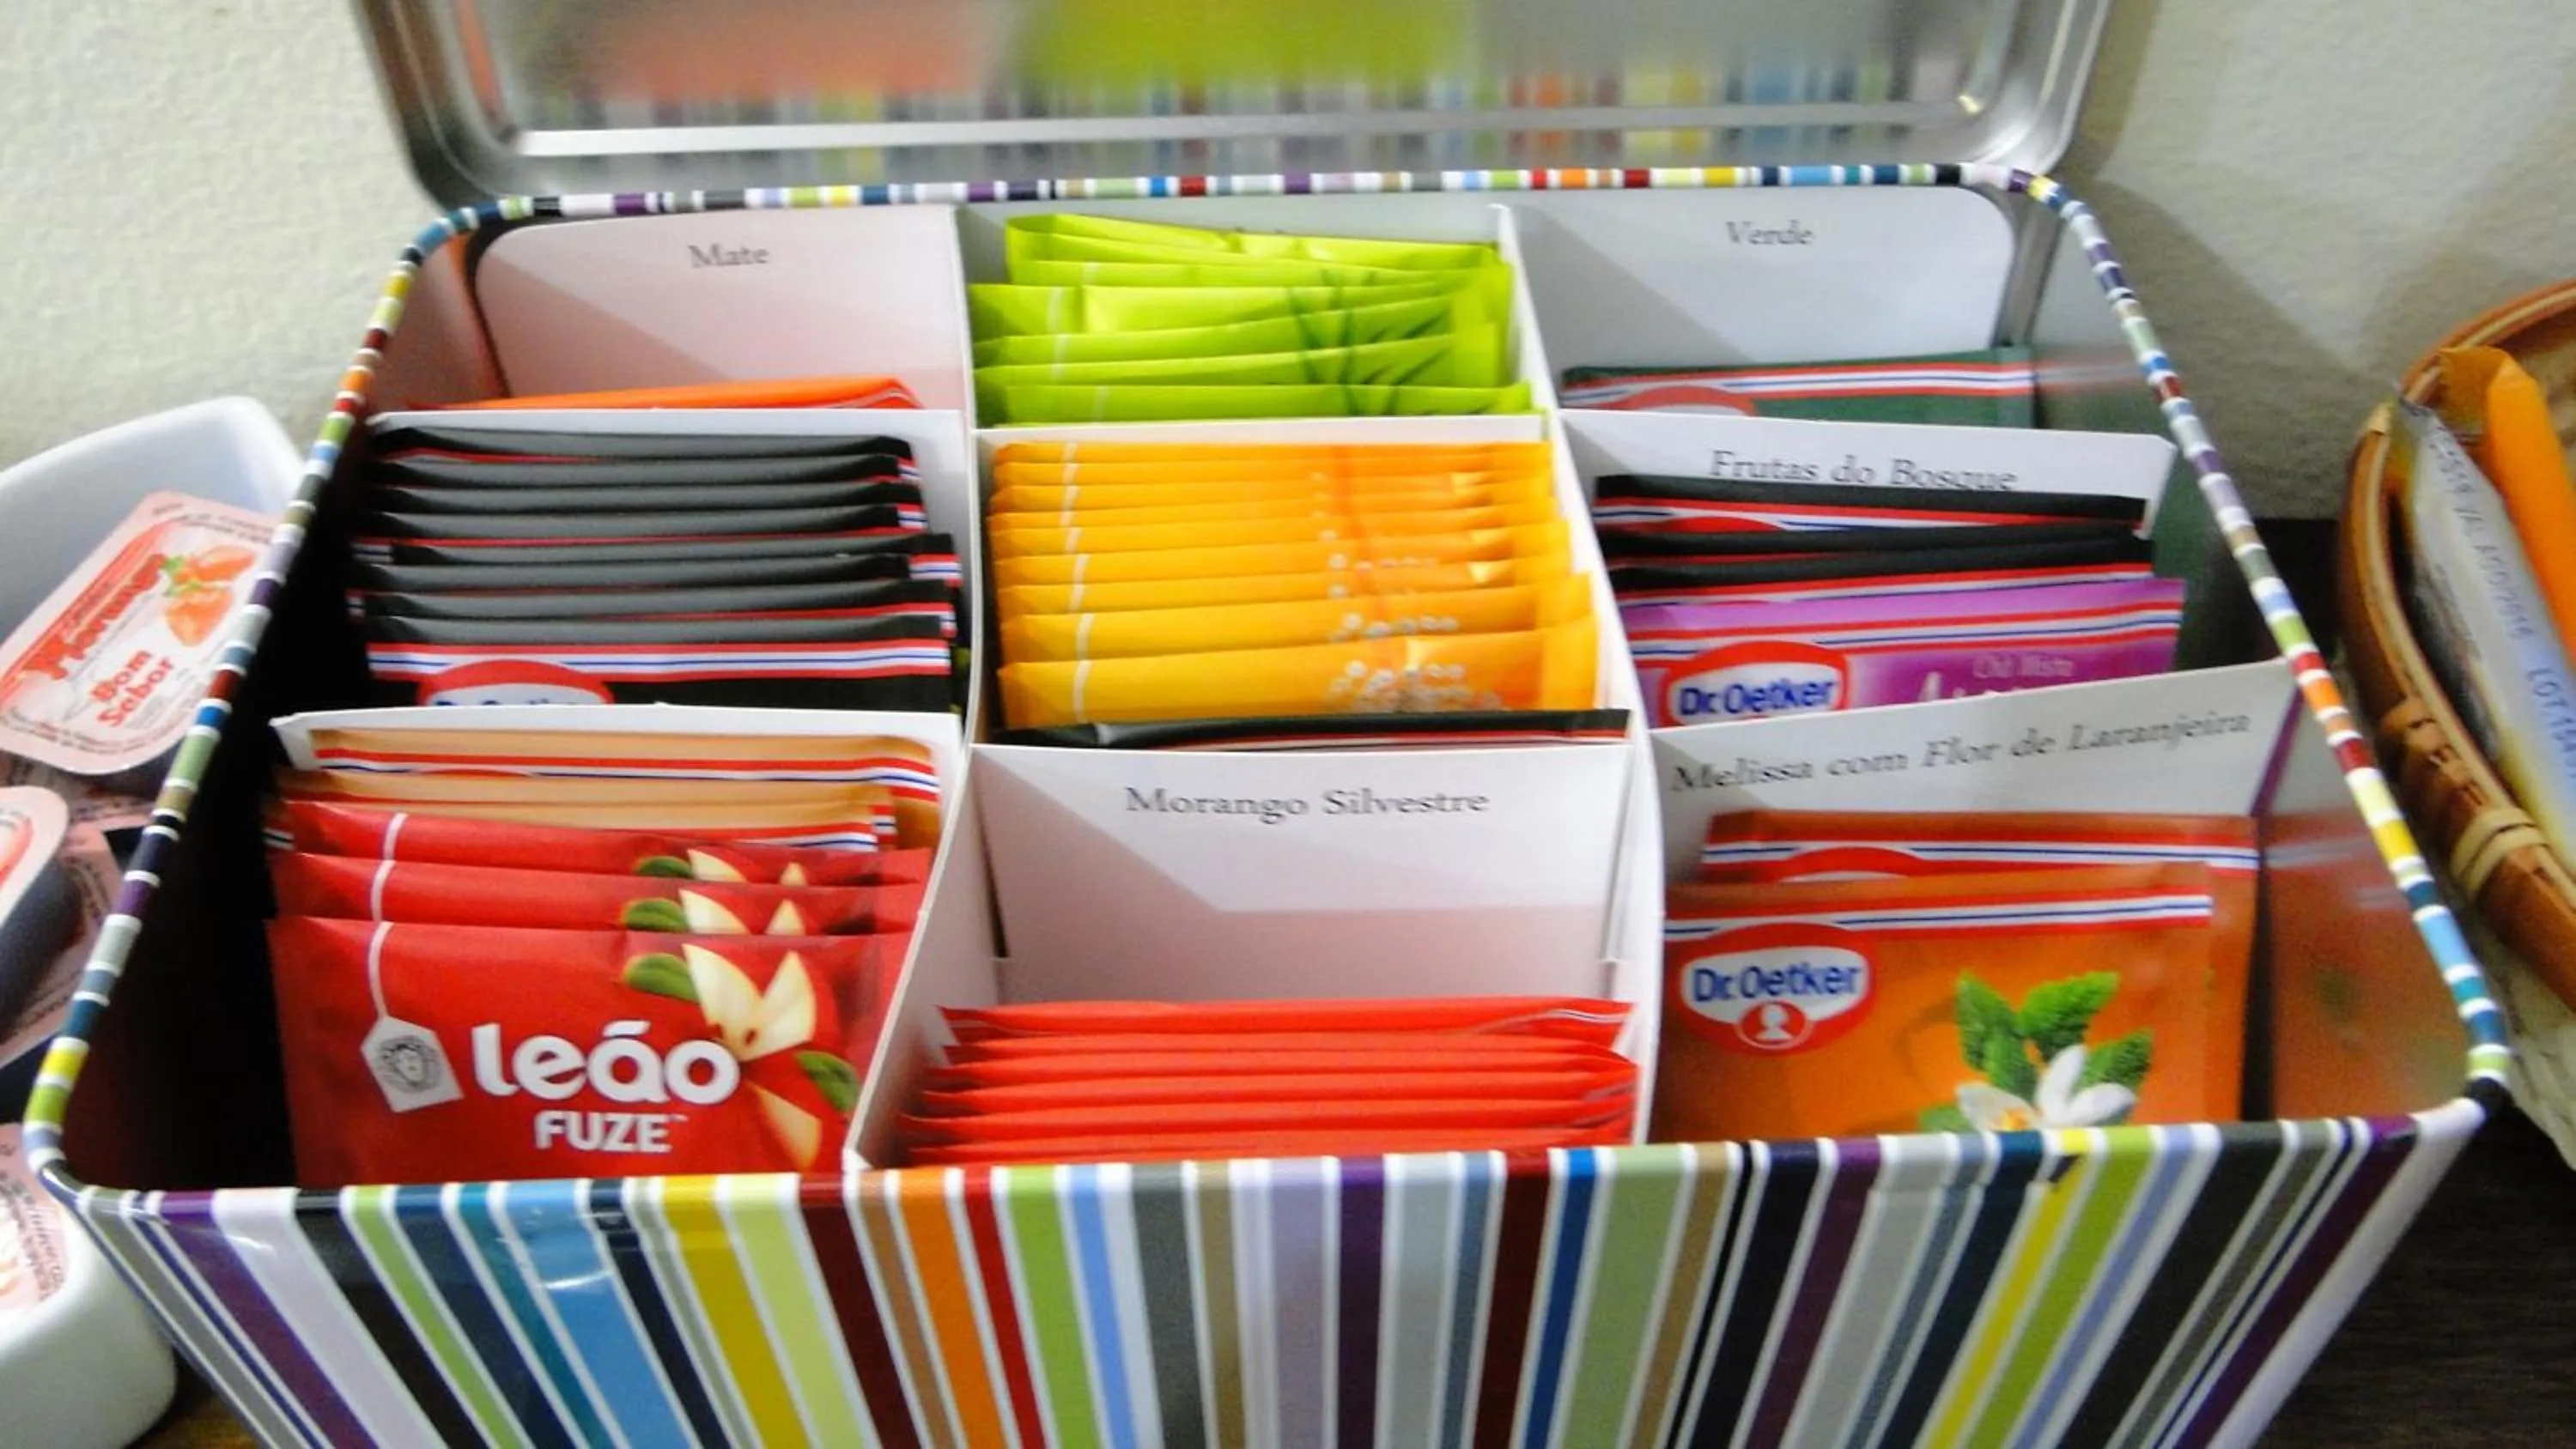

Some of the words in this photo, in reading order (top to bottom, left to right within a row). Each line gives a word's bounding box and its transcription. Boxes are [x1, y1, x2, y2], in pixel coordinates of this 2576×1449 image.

[1726, 219, 1814, 246] Verde
[688, 243, 769, 269] Mate
[1711, 449, 1818, 482] Frutas
[1831, 455, 1875, 485] do
[1891, 458, 2015, 490] Bosque
[90, 650, 152, 702] Bom
[97, 658, 174, 725] Sabor
[1724, 678, 1835, 714] Oetker
[1671, 757, 1814, 791] Melissa
[1826, 754, 1909, 776] com
[1922, 735, 2000, 767] Flor
[2010, 727, 2056, 756] de
[2066, 711, 2251, 750] Laranjeira
[1126, 785, 1309, 824] Morango
[1321, 786, 1490, 814] Silvestre
[1740, 963, 1861, 997] Oetker
[471, 1020, 740, 1104] leão
[534, 1111, 673, 1153] FUZE
